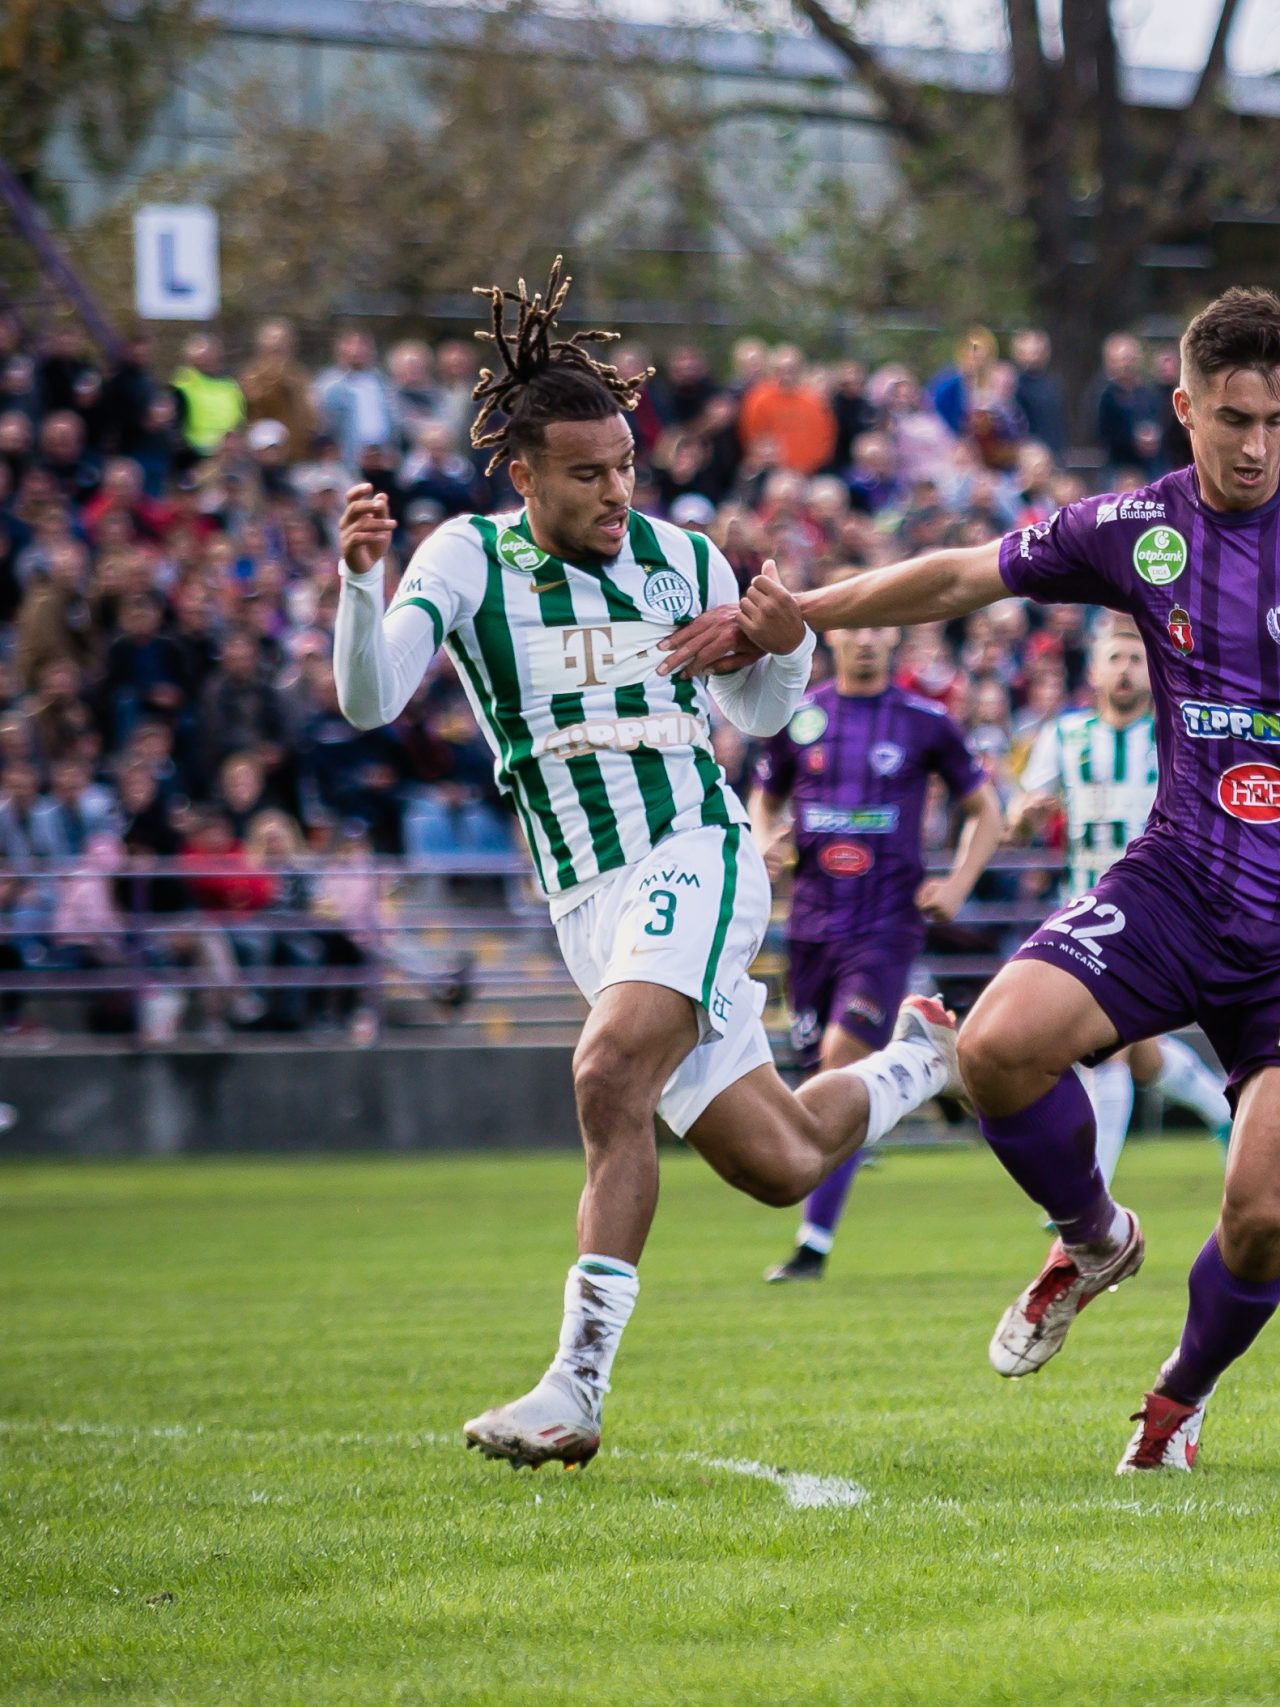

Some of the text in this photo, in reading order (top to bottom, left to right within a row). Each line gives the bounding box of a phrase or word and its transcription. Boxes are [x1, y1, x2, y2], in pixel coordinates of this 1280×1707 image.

[157, 230, 198, 299] L
[1137, 549, 1183, 564] otpbank
[639, 870, 700, 891] MVM
[644, 889, 677, 936] 3
[1043, 895, 1126, 969] 22
[1059, 942, 1101, 976] MECANO
